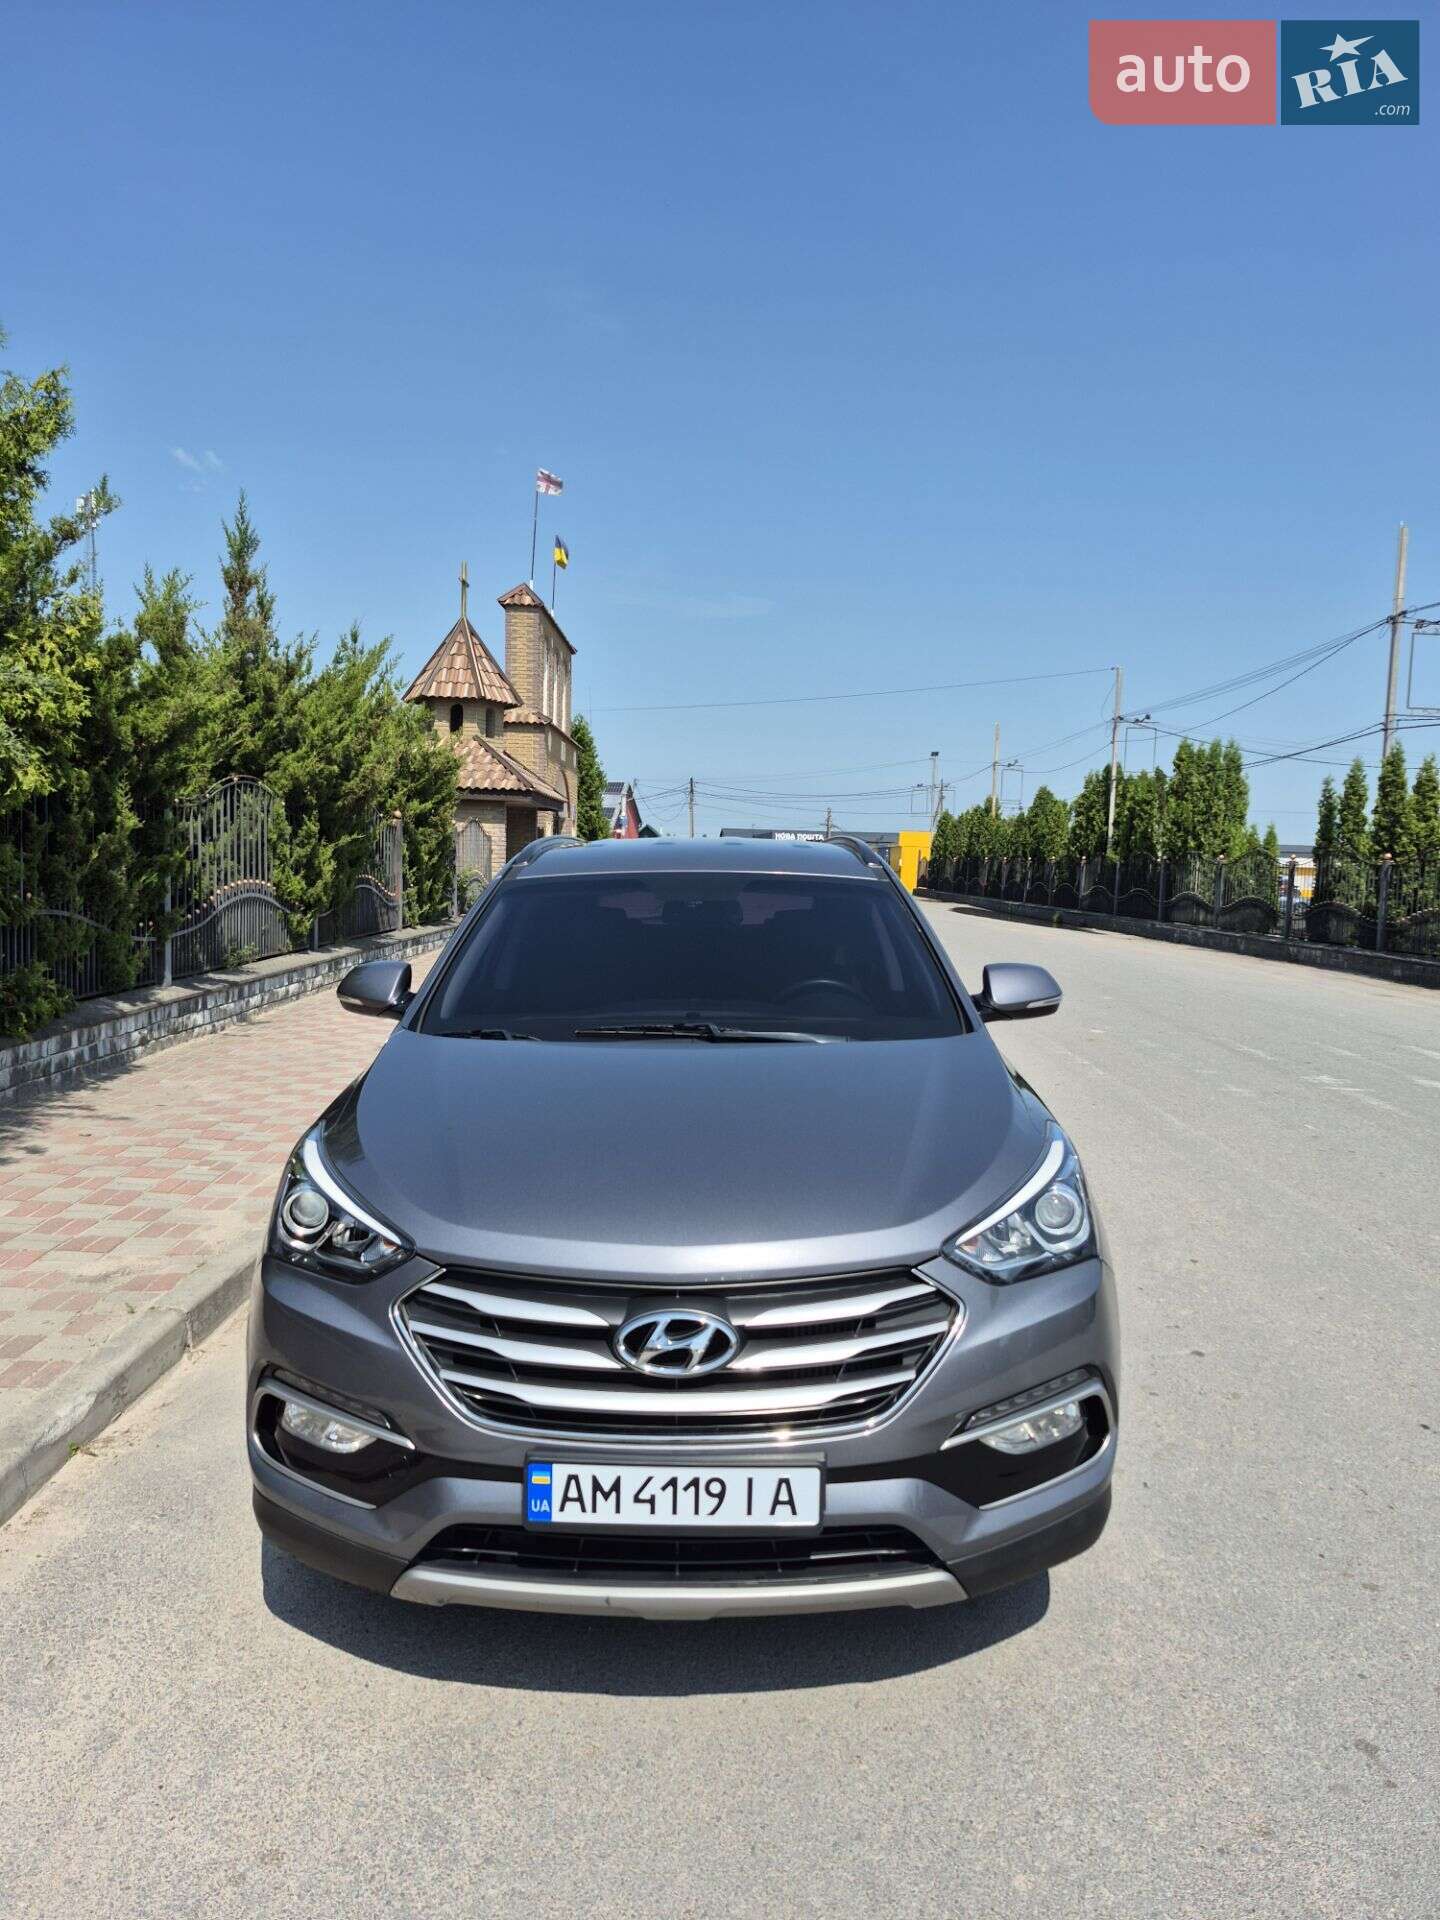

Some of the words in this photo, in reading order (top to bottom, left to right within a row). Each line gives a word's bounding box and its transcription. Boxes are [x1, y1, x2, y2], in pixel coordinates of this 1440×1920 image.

[775, 832, 796, 841] НОВА
[797, 833, 825, 841] ПОШТА
[559, 1473, 621, 1514] AM
[633, 1476, 727, 1516] 4119
[531, 1498, 550, 1512] UA
